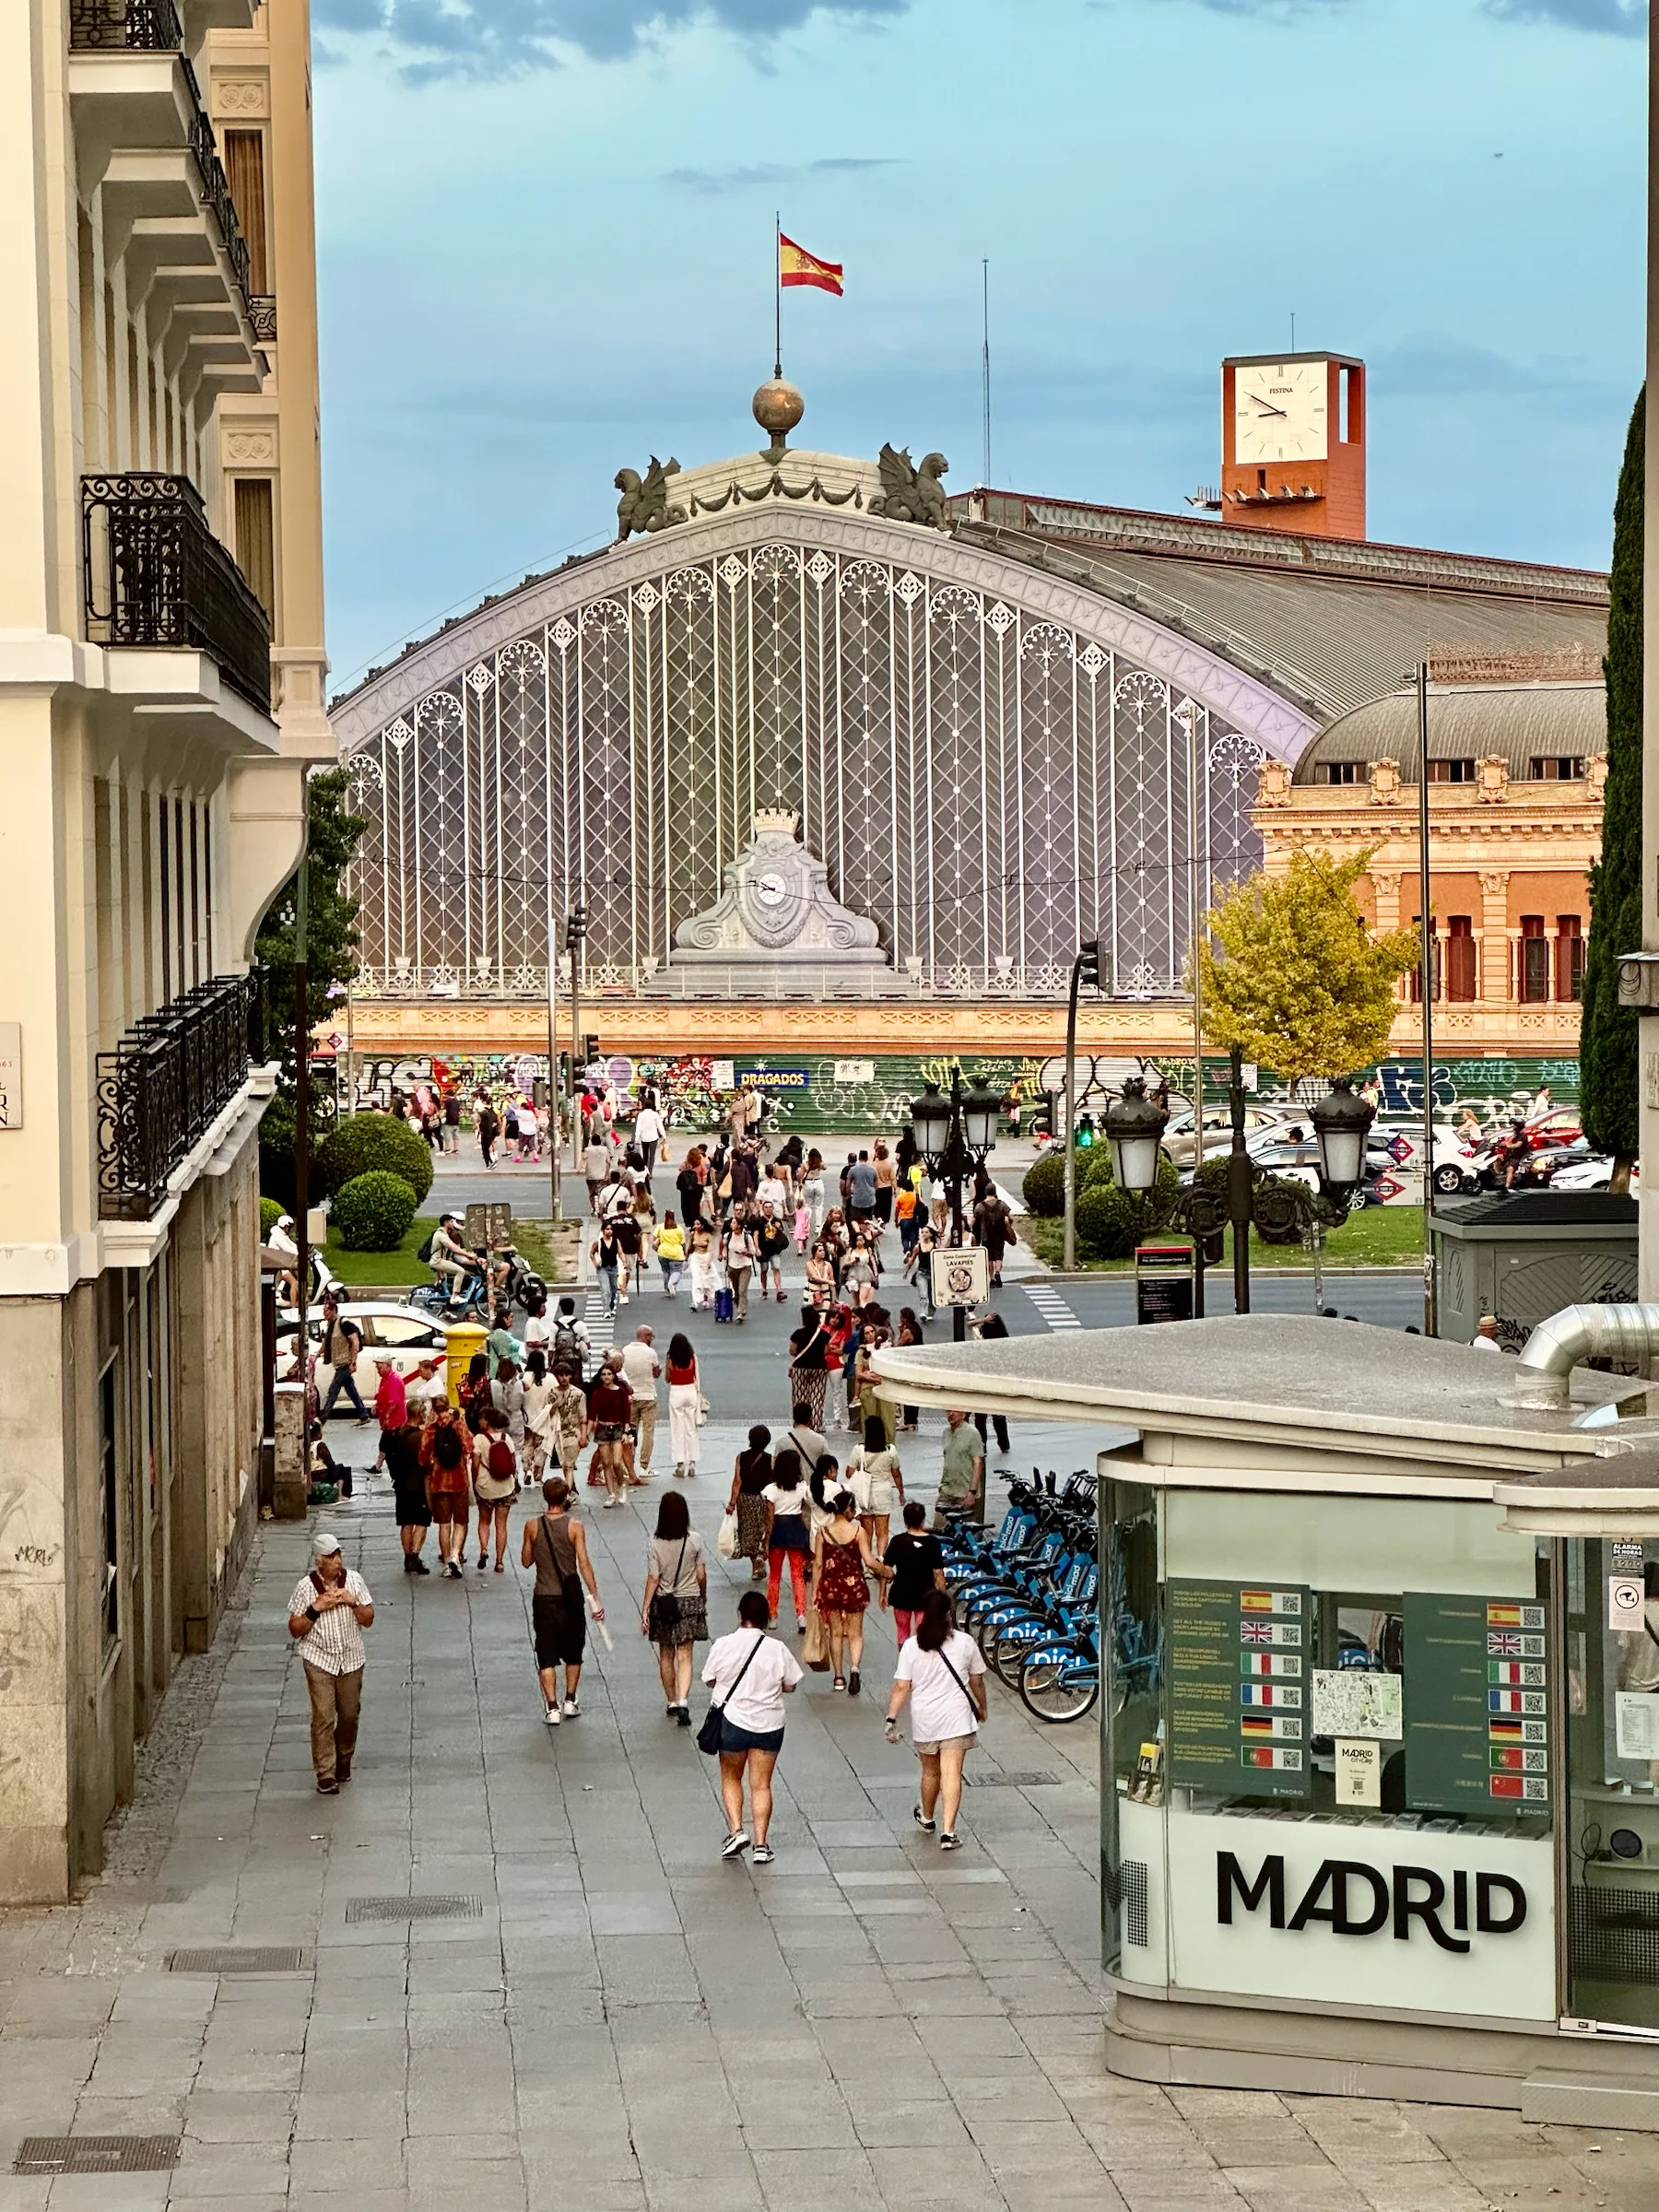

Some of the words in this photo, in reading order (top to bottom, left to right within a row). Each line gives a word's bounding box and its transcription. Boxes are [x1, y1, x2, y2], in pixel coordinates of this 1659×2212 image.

[741, 1073, 805, 1086] DRAGADOS
[1342, 1748, 1373, 1759] MADRID
[1279, 1788, 1304, 1796] MADRID
[1217, 1851, 1527, 1954] MADRID
